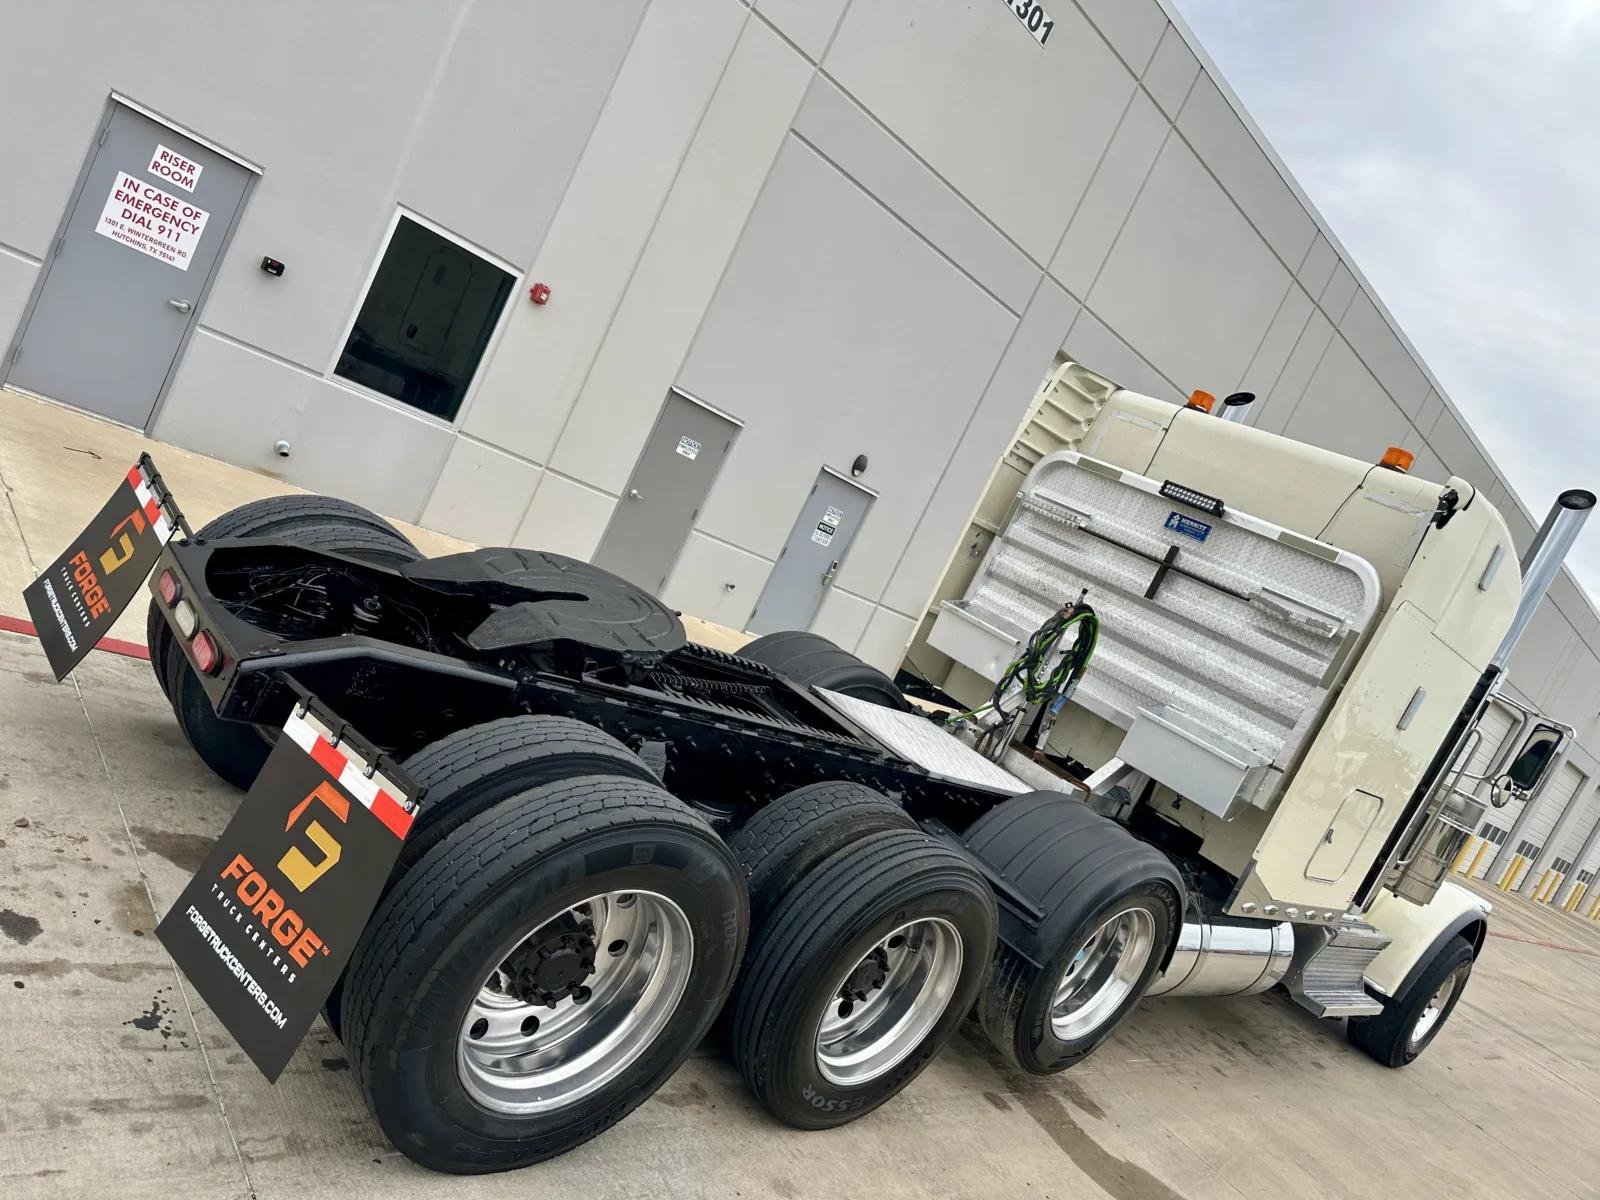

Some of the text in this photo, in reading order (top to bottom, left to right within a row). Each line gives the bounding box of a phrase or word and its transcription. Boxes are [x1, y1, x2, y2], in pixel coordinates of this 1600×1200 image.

[1007, 0, 1054, 45] 301
[151, 160, 194, 189] ROOM
[160, 151, 196, 175] RISER
[114, 189, 200, 235] EMERGENCY
[122, 178, 202, 221] IN CASE OF
[105, 217, 118, 227] 1301
[127, 227, 176, 253] WINTERGREEN
[121, 208, 181, 242] DIAL 911
[149, 246, 158, 255] TX
[69, 550, 105, 619] FORGE
[220, 853, 323, 969] FORGE
[210, 883, 297, 984] TRUCK CENTERS
[185, 904, 288, 1030] FORGETRUCKCENTERS.COM
